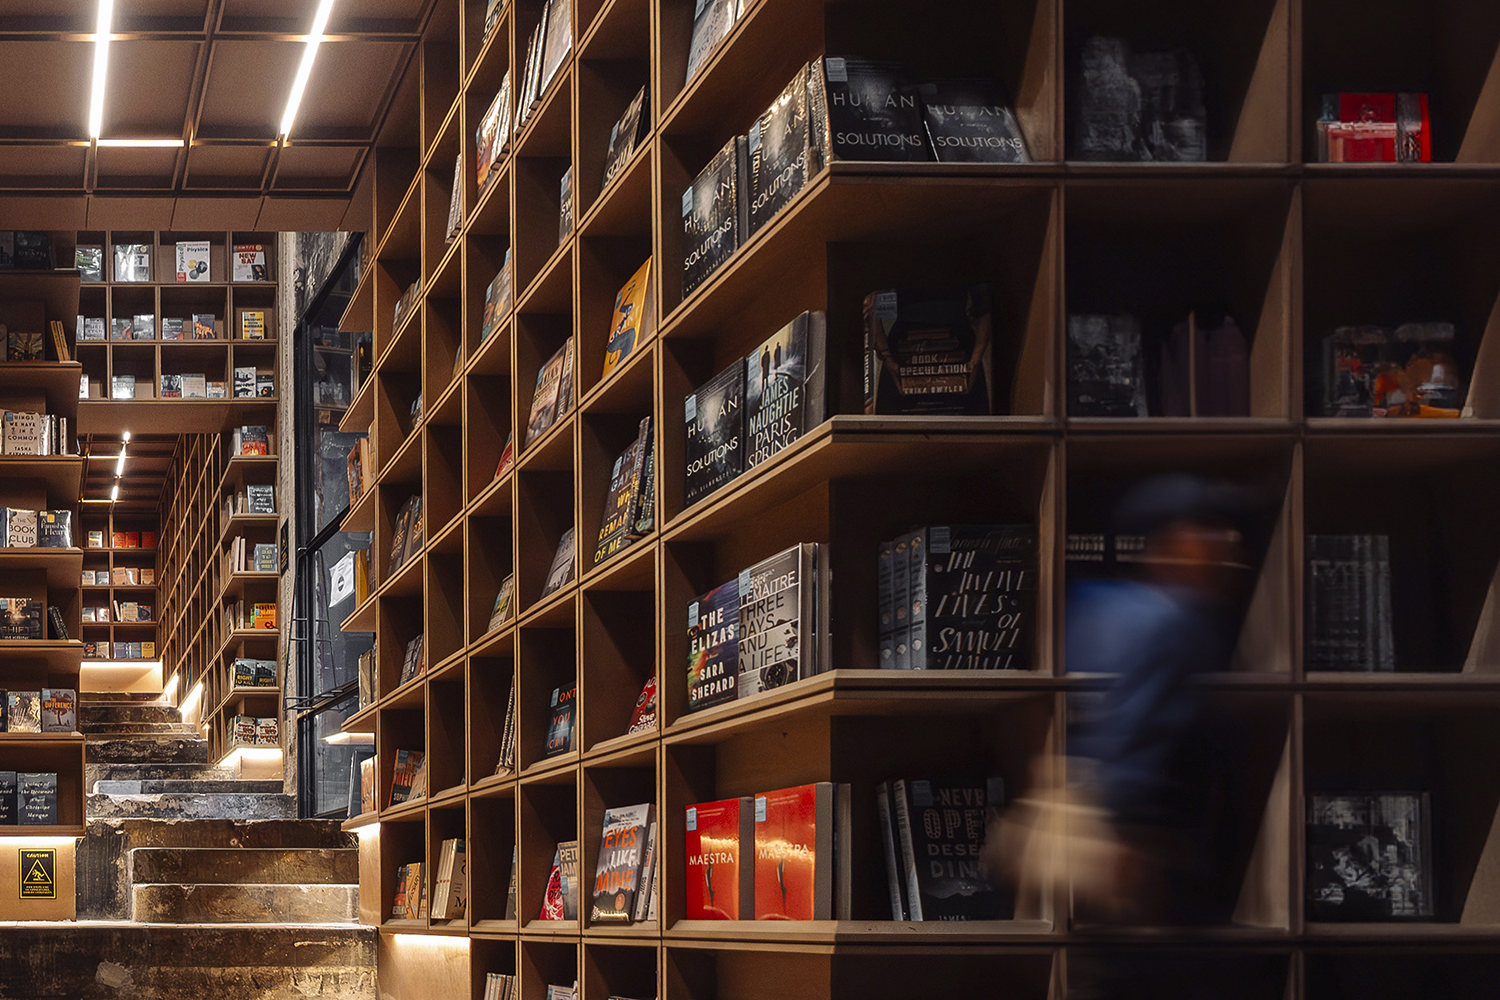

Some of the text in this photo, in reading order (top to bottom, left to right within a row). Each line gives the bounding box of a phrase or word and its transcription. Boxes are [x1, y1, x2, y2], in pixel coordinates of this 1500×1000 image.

[837, 132, 922, 147] SOLUTIONS
[937, 136, 1022, 149] SOLUTIONS
[751, 151, 806, 215] SOLUTIONS
[684, 217, 732, 271] SOLUTIONS
[900, 364, 967, 376] SPECULATION
[760, 376, 788, 409] JAMES
[687, 395, 738, 438] HUAN
[749, 386, 799, 437] NAUGHTIE
[755, 413, 792, 451] PARIS
[687, 437, 739, 477] SOLUTIONS
[748, 428, 798, 468] SPRING
[9, 525, 35, 534] BOOK
[9, 535, 34, 544] CLUB
[594, 536, 622, 563] OF ME
[701, 607, 724, 630] THE
[740, 592, 785, 622] THREE
[740, 613, 775, 639] DAYS
[691, 623, 735, 655] ELIZAS
[740, 632, 768, 656] AND
[740, 644, 785, 673] A LIFE
[700, 661, 724, 681] SARA
[691, 675, 735, 701] SHEPARD
[44, 702, 73, 710] DIFFERENCE
[553, 711, 571, 726] YOU
[637, 712, 655, 725] Steve
[604, 826, 638, 849] EYES
[610, 849, 641, 867] LIKE
[689, 852, 735, 866] MAESTRA
[595, 870, 634, 892] MINE
